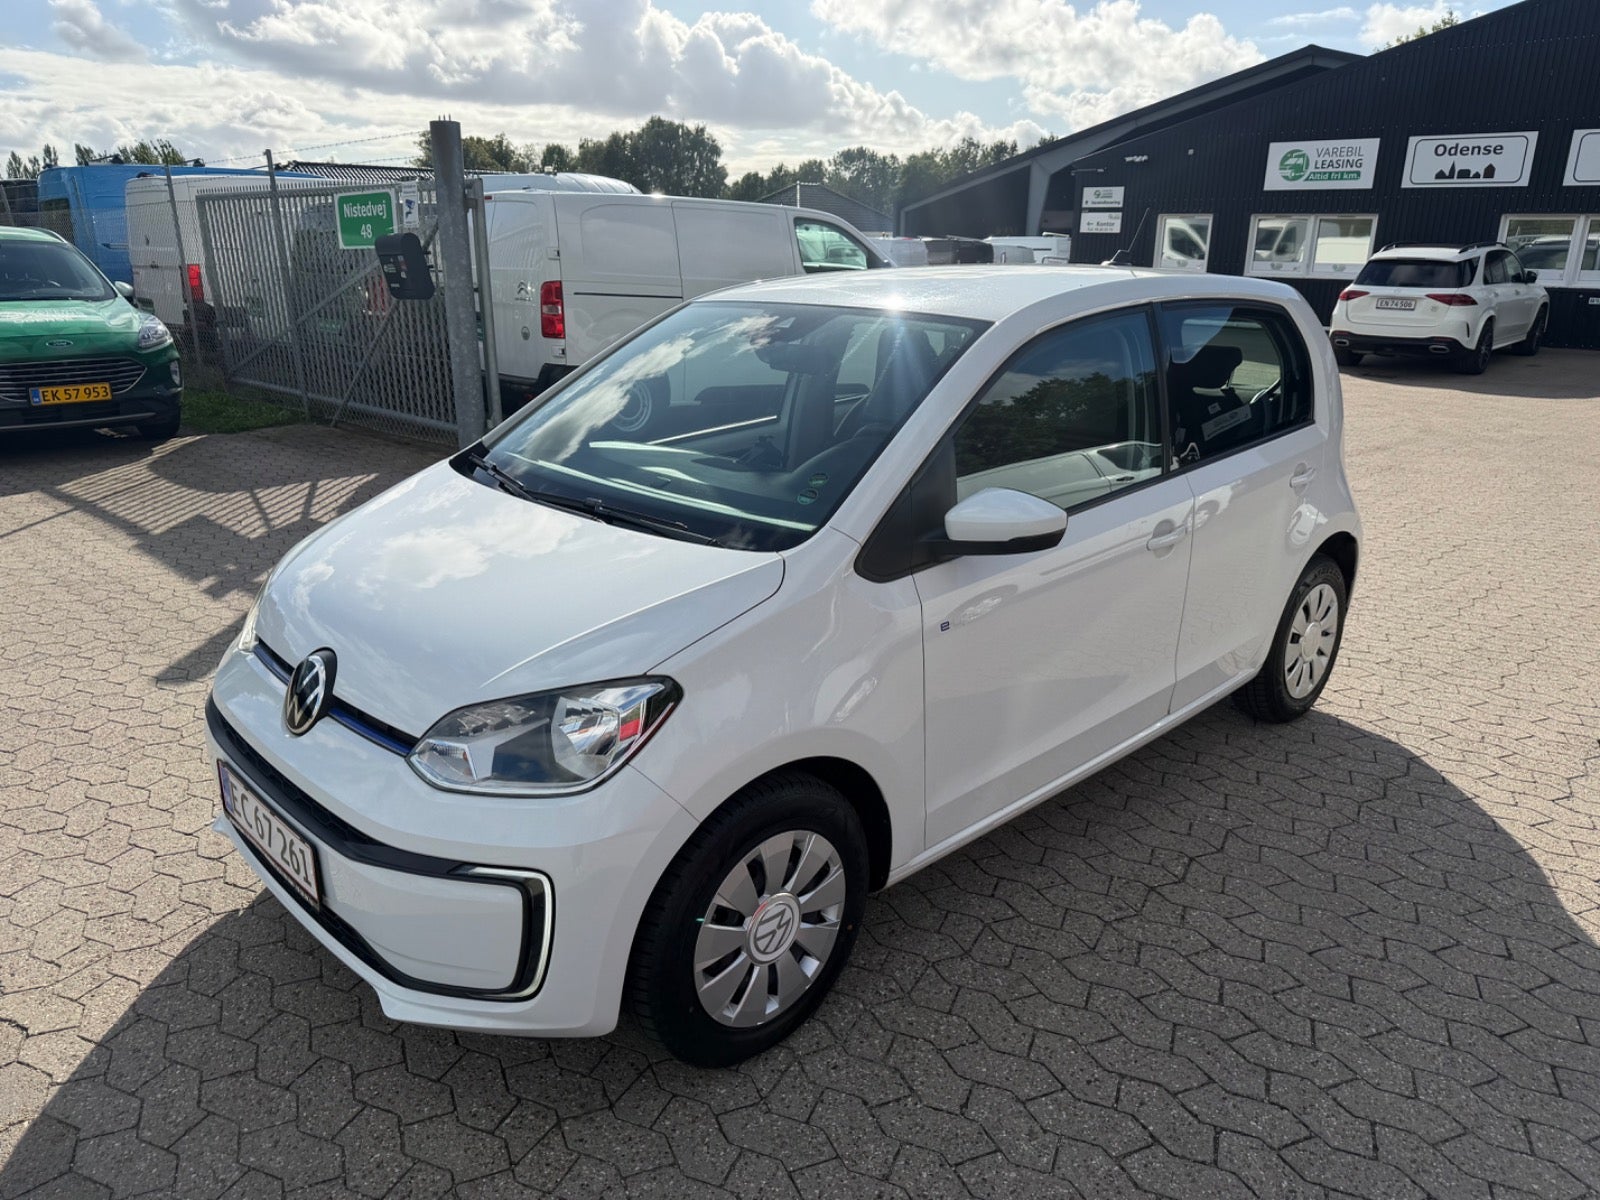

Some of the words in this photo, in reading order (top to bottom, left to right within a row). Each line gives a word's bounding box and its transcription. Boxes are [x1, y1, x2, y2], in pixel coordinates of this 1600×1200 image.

[1316, 146, 1364, 158] VAREBIL
[1434, 142, 1504, 157] Odense
[1314, 158, 1363, 170] LEASING
[1308, 172, 1329, 180] Altid
[1343, 171, 1360, 179] km.
[343, 200, 387, 219] Nistedvej
[360, 223, 373, 239] 48
[41, 389, 61, 402] EK
[64, 388, 80, 400] 57
[83, 386, 109, 399] 953
[229, 779, 253, 829] EC
[254, 805, 272, 849] 67
[276, 826, 312, 888] 261
